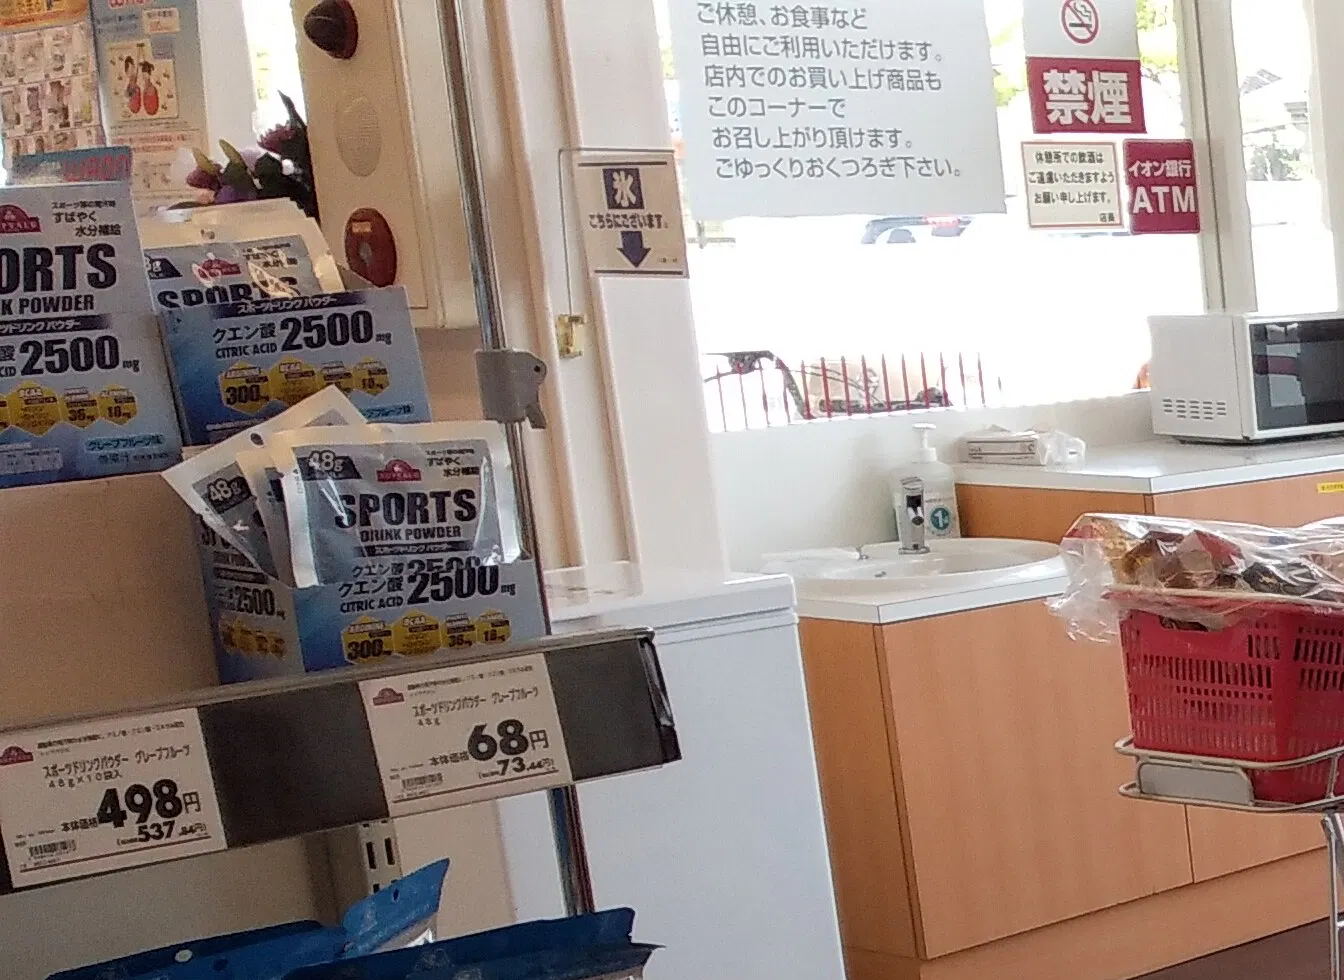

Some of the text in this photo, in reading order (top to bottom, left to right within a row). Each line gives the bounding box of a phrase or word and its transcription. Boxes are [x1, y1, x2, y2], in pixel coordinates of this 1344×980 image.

[697, 3, 868, 30] ご休憩、お食事など
[701, 33, 942, 62] 自由にご利用いただけます。
[705, 66, 942, 91] 店内でのお買い上げ商品も
[708, 96, 846, 119] このコーナーで
[1043, 69, 1131, 125] 禁煙
[712, 126, 912, 149] お召し上がり頂けます。
[715, 158, 961, 179] ごゆっくりおくつろぎ下さい。
[1128, 159, 1192, 178] イオン銀行
[612, 170, 638, 208] 氷
[1034, 192, 1111, 204] お願い申し上げます。
[1132, 185, 1196, 214] ATM
[53, 211, 97, 223] すばやく
[589, 213, 668, 229] こちらにございます。
[75, 225, 121, 237] 水分補給
[0, 243, 116, 296] ORTS
[19, 295, 94, 314] POWDER
[212, 310, 373, 352] クエン酸 2500
[20, 335, 120, 376] 2500
[215, 342, 277, 359] CITRIC ACID
[309, 449, 344, 473] 48g
[335, 490, 476, 529] SPORTS
[360, 526, 461, 542] DRINK POWDER
[338, 566, 498, 605] クエン酸 2500
[340, 596, 403, 614] CITRIC ACID
[428, 719, 549, 766] 本体価格 68円
[61, 779, 201, 832] 本体価格 498円
